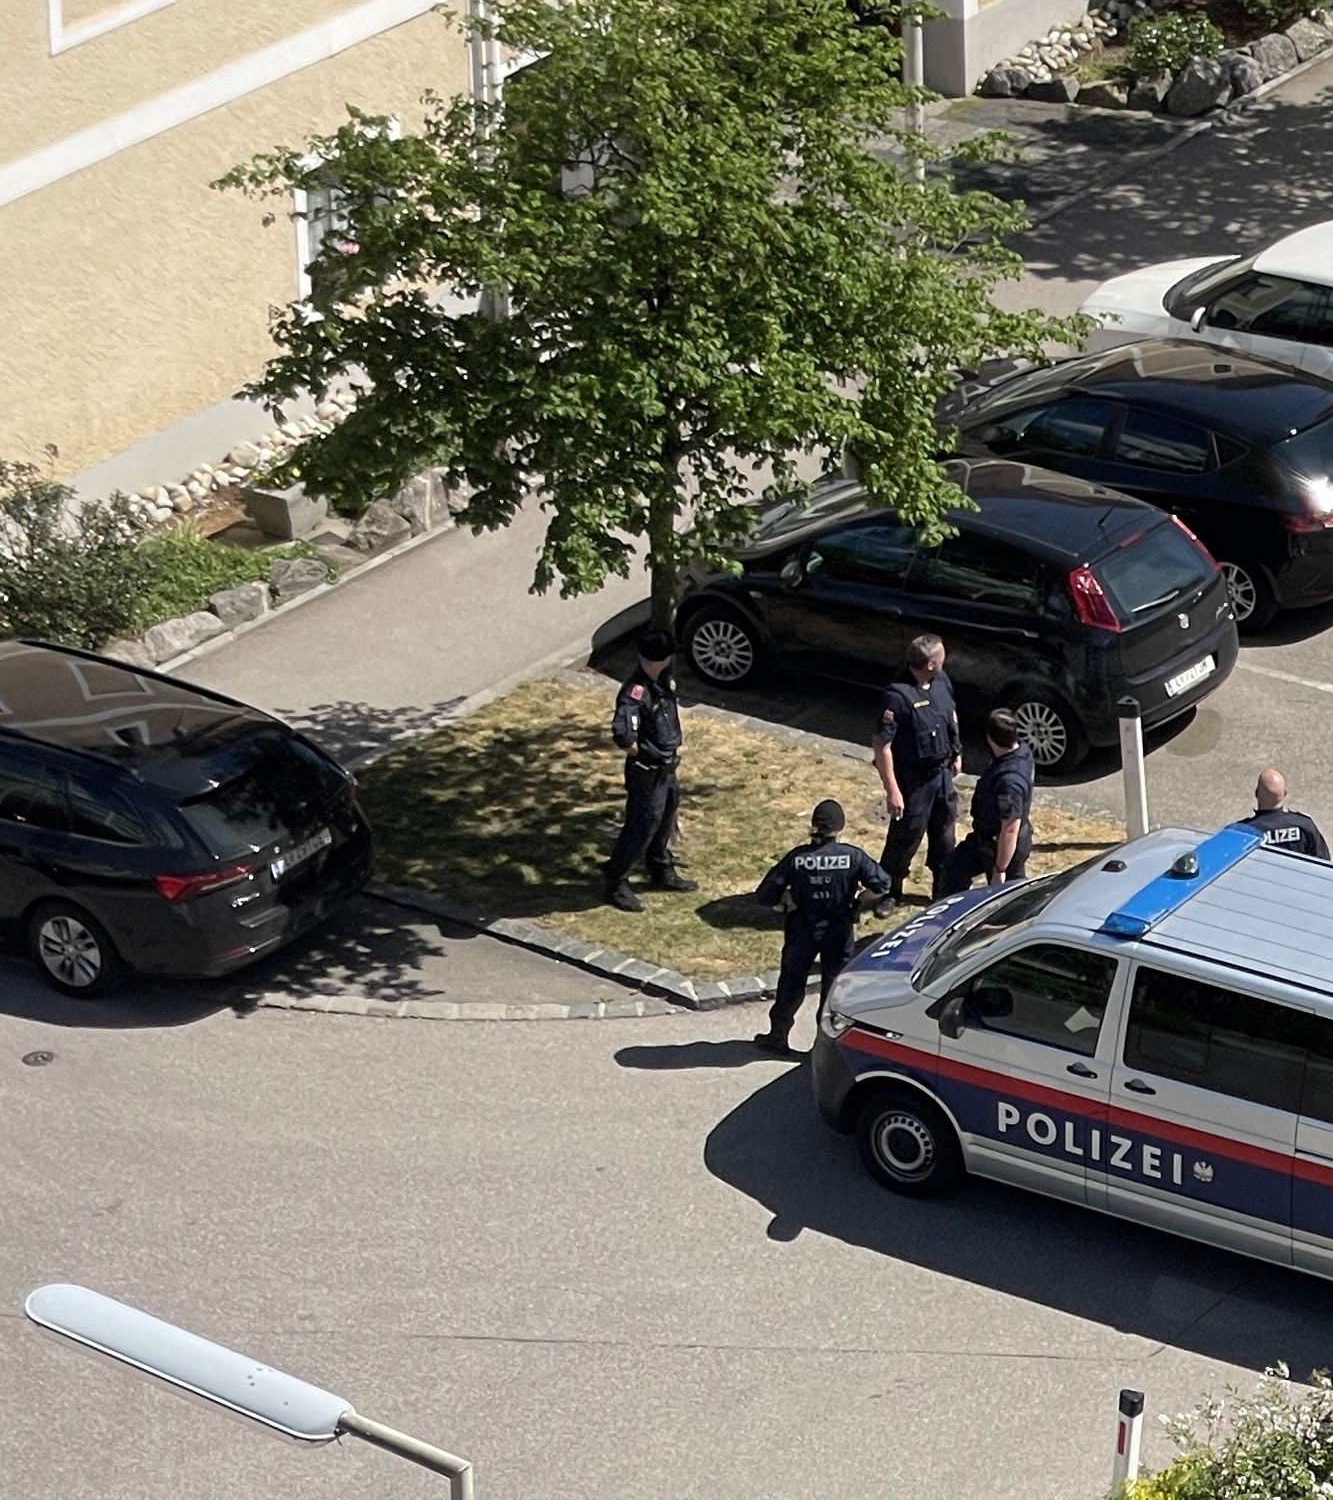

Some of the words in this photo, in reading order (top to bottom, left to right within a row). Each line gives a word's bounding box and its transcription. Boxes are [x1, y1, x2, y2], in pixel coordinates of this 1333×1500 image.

[1263, 827, 1300, 844] LIZEI
[795, 855, 850, 870] POLIZEI
[998, 1101, 1182, 1185] POLIZEI
